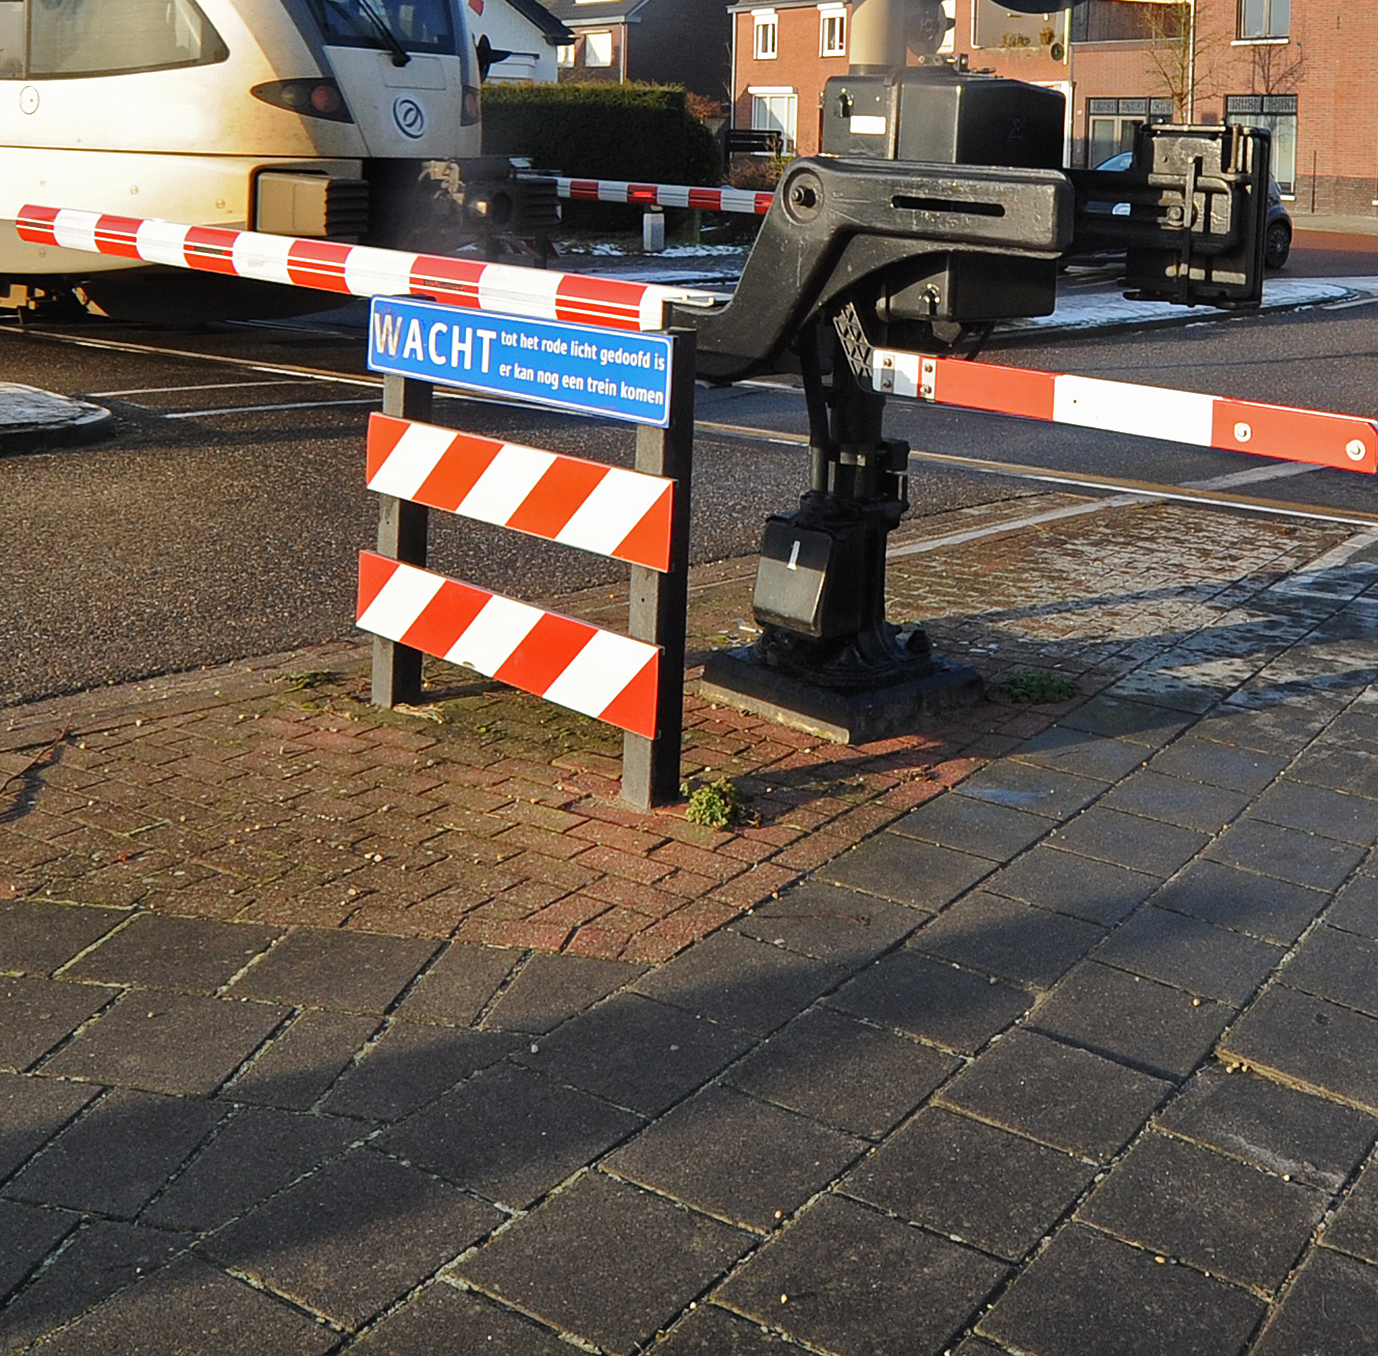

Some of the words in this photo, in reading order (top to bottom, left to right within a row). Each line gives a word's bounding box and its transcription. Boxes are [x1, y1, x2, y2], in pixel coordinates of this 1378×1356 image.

[374, 312, 497, 373] WACHT
[501, 331, 518, 347] tot
[520, 332, 540, 351] het
[541, 338, 568, 355] rode
[570, 340, 598, 360] licht
[600, 347, 651, 369] gedoofd
[654, 353, 665, 371] is
[499, 364, 512, 377] er
[514, 362, 534, 382] kan
[537, 370, 560, 390] nog
[562, 374, 584, 391] een
[587, 376, 618, 396] trein
[620, 381, 664, 405] komen
